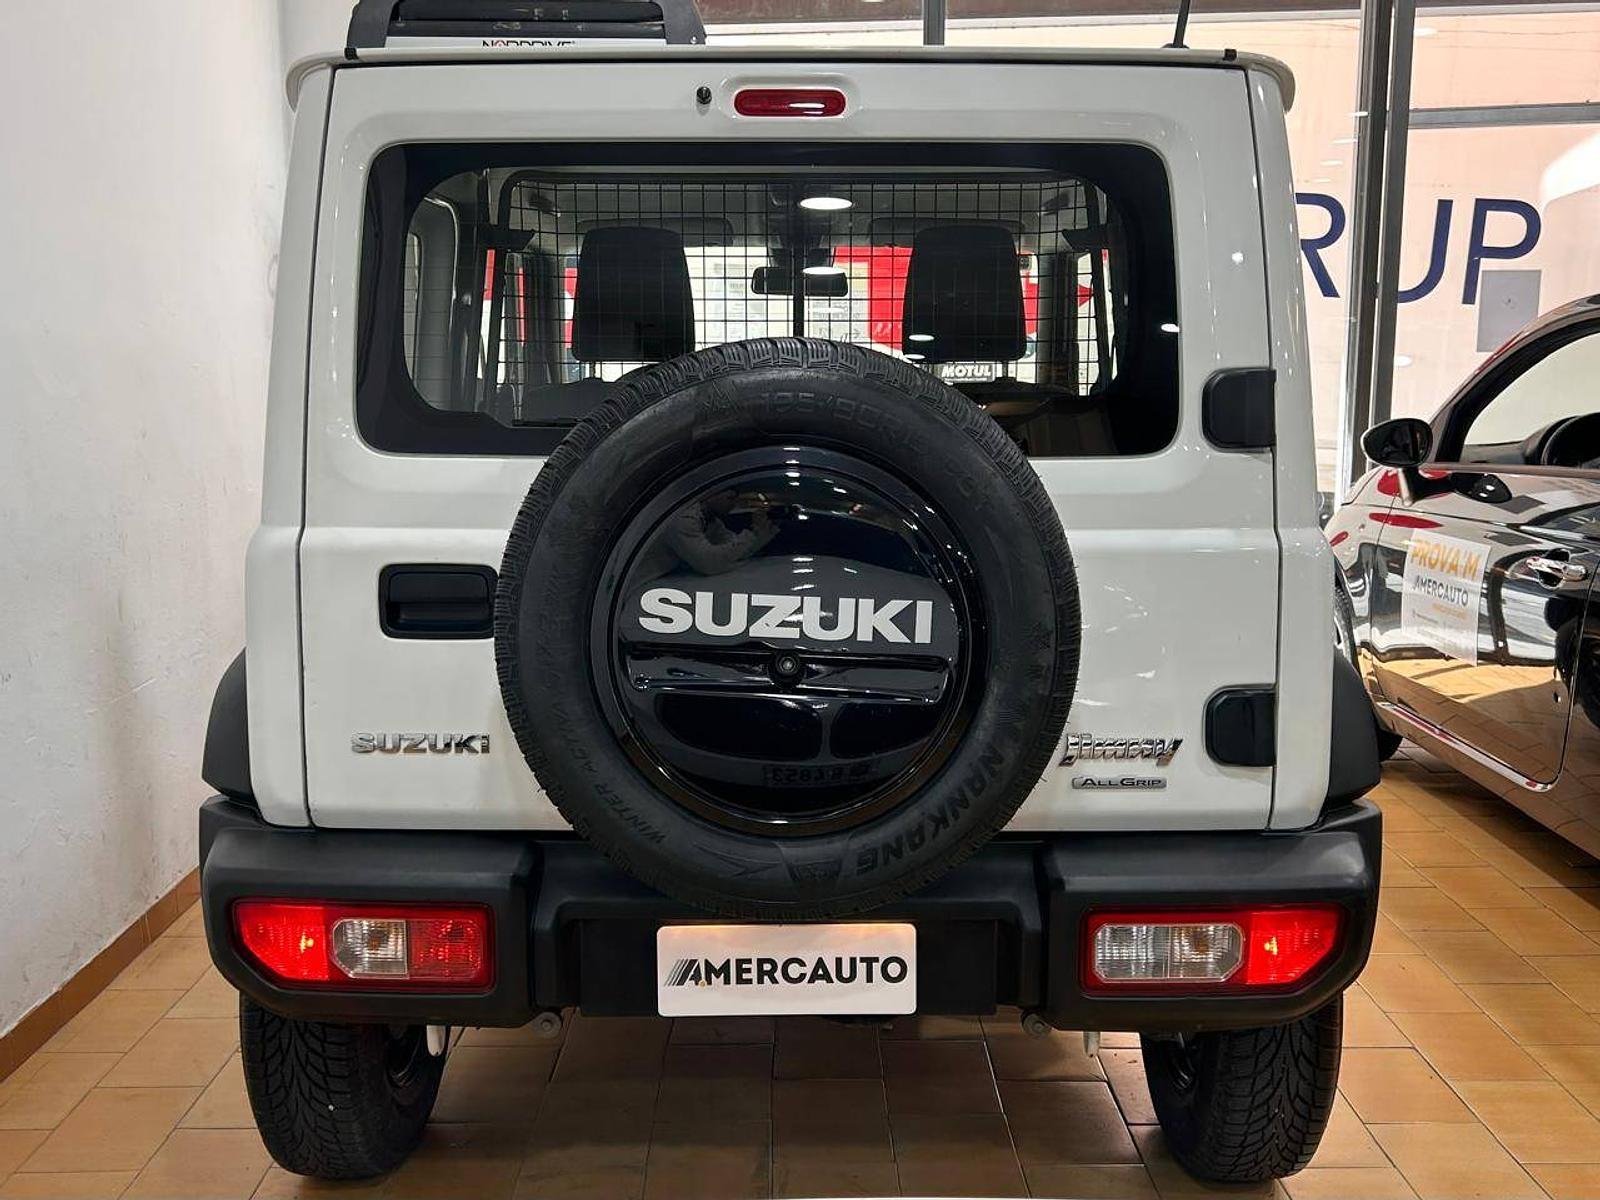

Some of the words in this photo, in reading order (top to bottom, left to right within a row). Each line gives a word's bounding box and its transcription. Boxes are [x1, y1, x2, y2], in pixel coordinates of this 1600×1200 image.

[941, 364, 991, 377] MOTUL
[1412, 575, 1469, 607] AMERCAUTO
[638, 587, 933, 644] SUZUKI
[351, 732, 490, 754] SUZUKI
[1059, 733, 1183, 766] Jimny
[664, 956, 908, 987] AMERCAUTO
